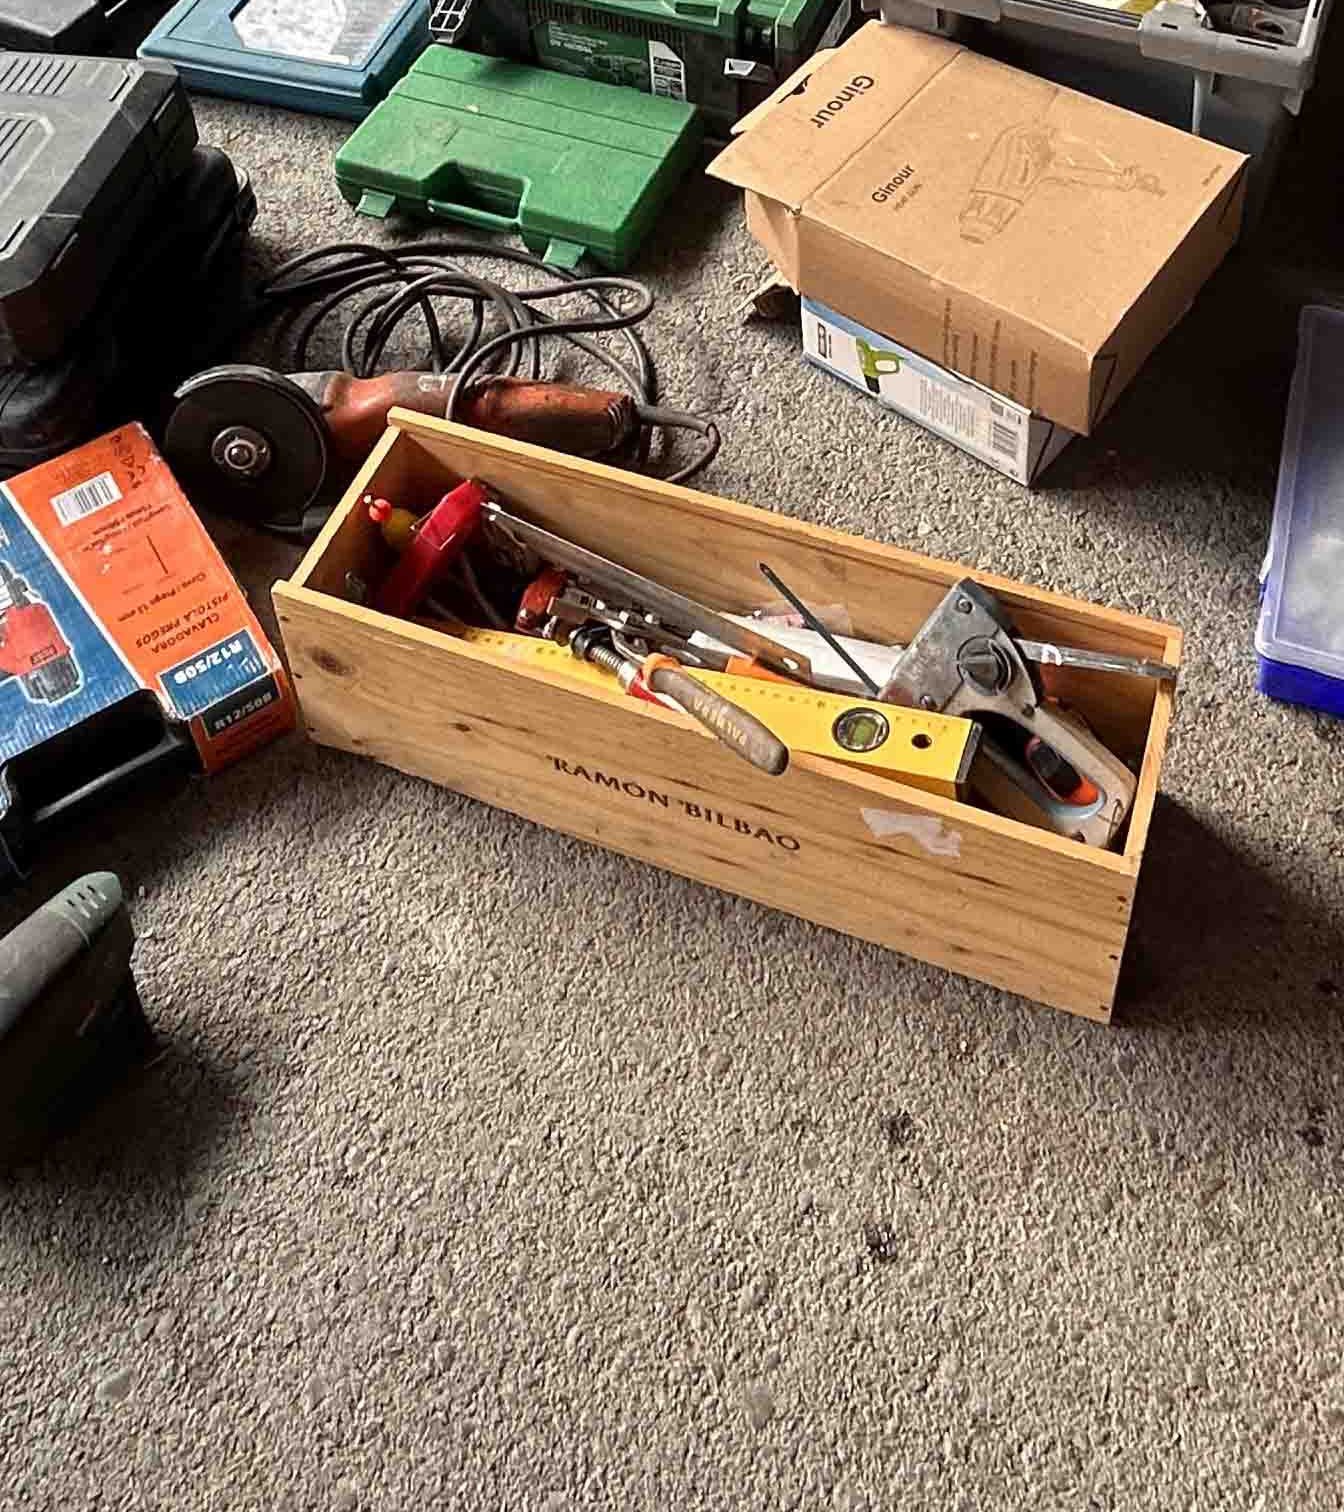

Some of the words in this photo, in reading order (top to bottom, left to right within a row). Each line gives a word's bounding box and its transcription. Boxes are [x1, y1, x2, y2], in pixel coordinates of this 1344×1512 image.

[809, 74, 875, 129] Ginour
[871, 164, 915, 204] Ginour
[150, 611, 221, 655] CLAVADORA
[173, 638, 244, 685] R12/50B
[678, 799, 801, 852] BILBAO
